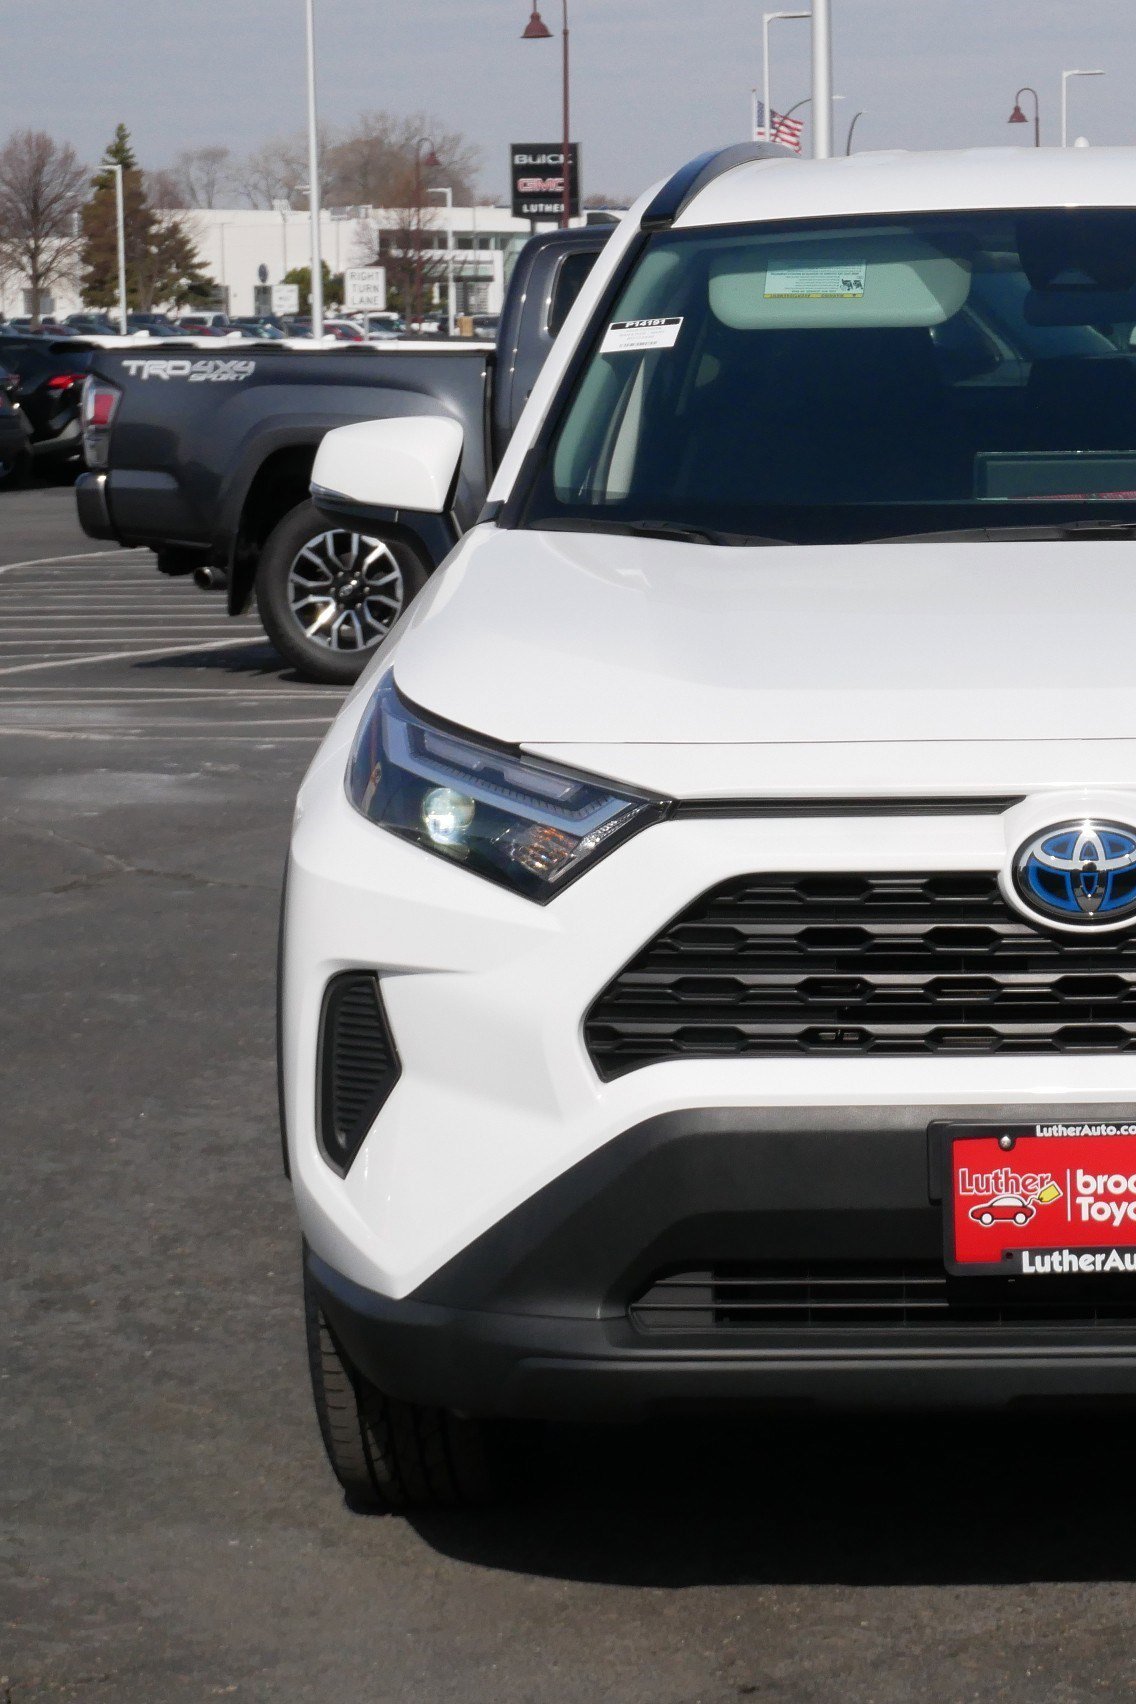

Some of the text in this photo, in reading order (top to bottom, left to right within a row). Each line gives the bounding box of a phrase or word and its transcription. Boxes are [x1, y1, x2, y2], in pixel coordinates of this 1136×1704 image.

[517, 177, 566, 193] GMC
[350, 271, 380, 281] RIGHT
[352, 284, 380, 293] TURN
[352, 296, 379, 305] LANE
[121, 359, 192, 381] TRD
[959, 1167, 1052, 1196] Luther
